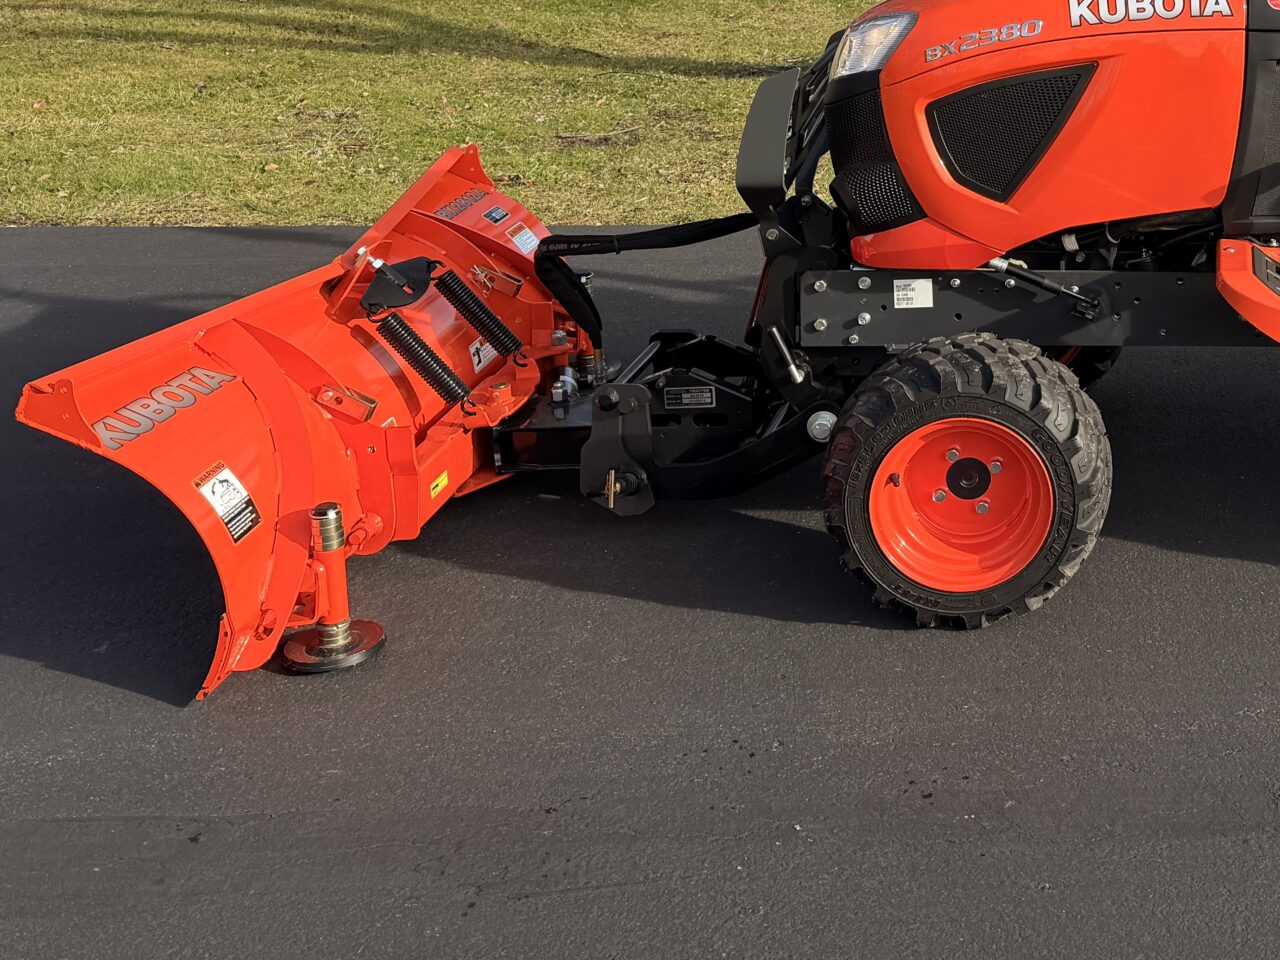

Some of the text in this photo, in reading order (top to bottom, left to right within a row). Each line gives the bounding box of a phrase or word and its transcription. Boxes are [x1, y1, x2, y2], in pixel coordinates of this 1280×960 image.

[924, 19, 1043, 62] BX2380
[94, 366, 236, 451] KUBOTA
[199, 461, 225, 484] WARNING
